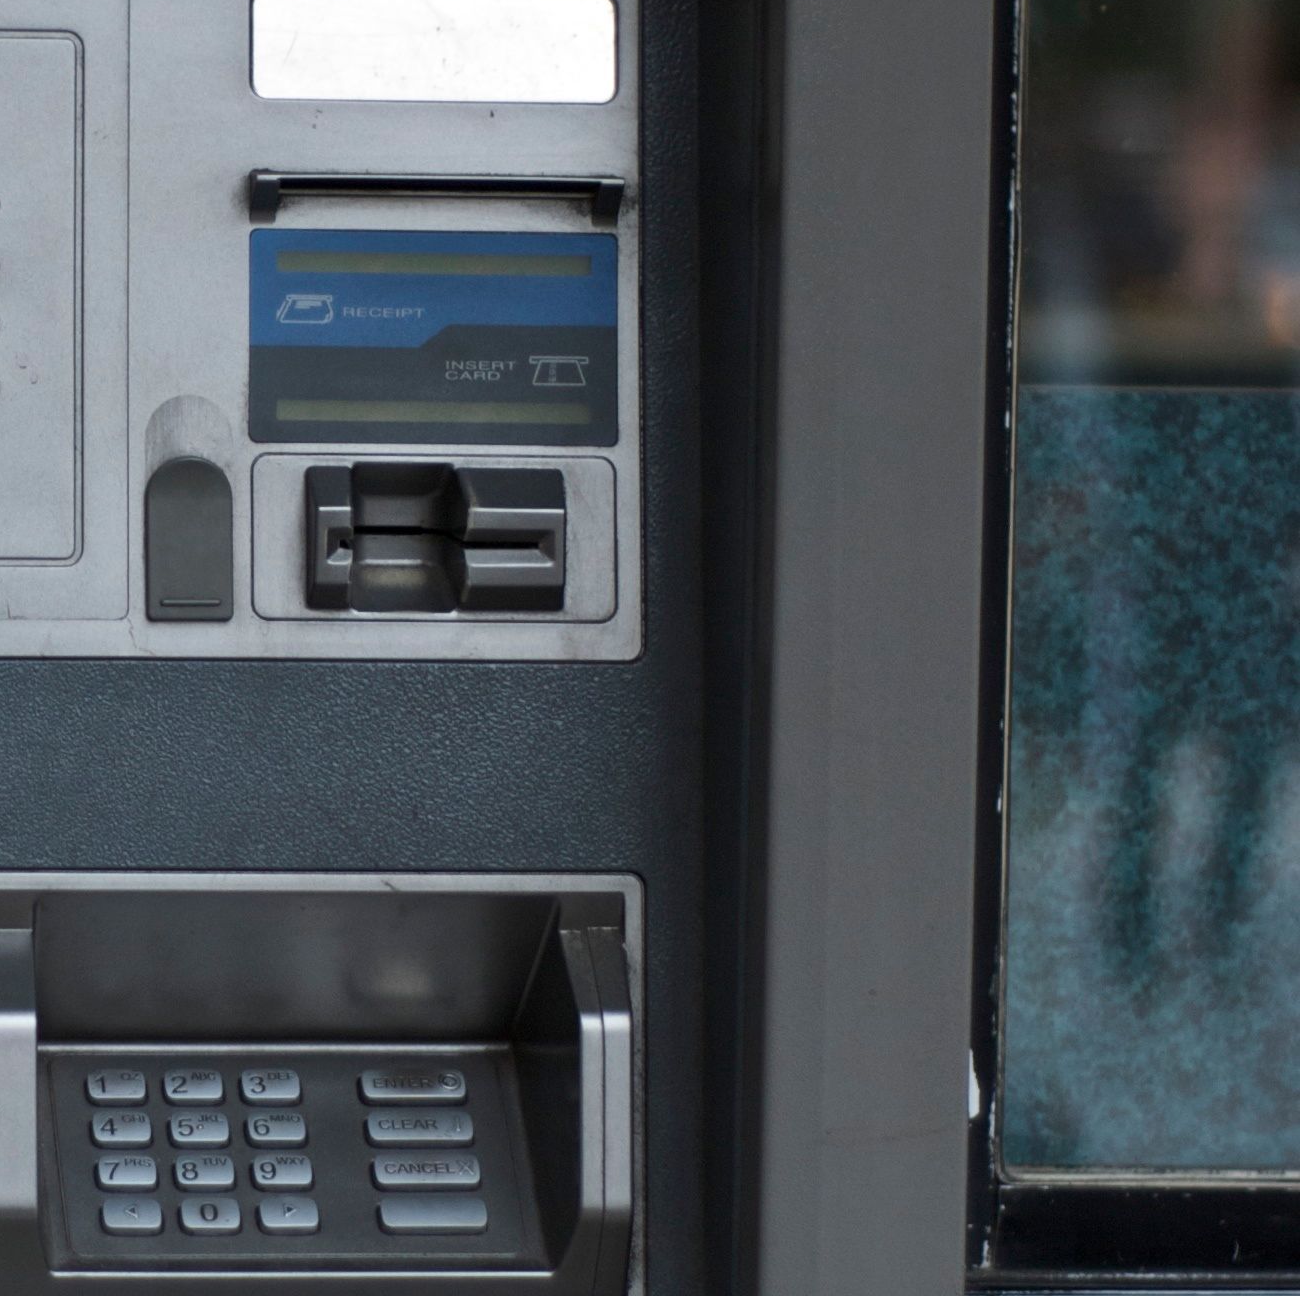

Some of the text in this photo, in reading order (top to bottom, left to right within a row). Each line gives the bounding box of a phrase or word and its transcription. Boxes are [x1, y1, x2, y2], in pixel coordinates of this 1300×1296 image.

[343, 307, 426, 319] RECEIPT
[444, 370, 501, 382] CARD
[445, 360, 517, 371] INSERT
[95, 1073, 141, 1094] 1 QZ
[171, 1072, 217, 1094] 2 ABC
[249, 1072, 294, 1094] 3 DEF
[372, 1076, 434, 1089] ENTER
[100, 1115, 146, 1136] 4 GHI
[177, 1114, 223, 1137] 5 JKL
[252, 1115, 301, 1136] 6 MNO
[378, 1117, 439, 1130] CLEAR
[104, 1158, 151, 1181] 7 PRS
[181, 1158, 228, 1181] 8 TUV
[259, 1156, 306, 1180] 9 WXY
[384, 1161, 455, 1175] CANCEL
[200, 1204, 219, 1222] 0
